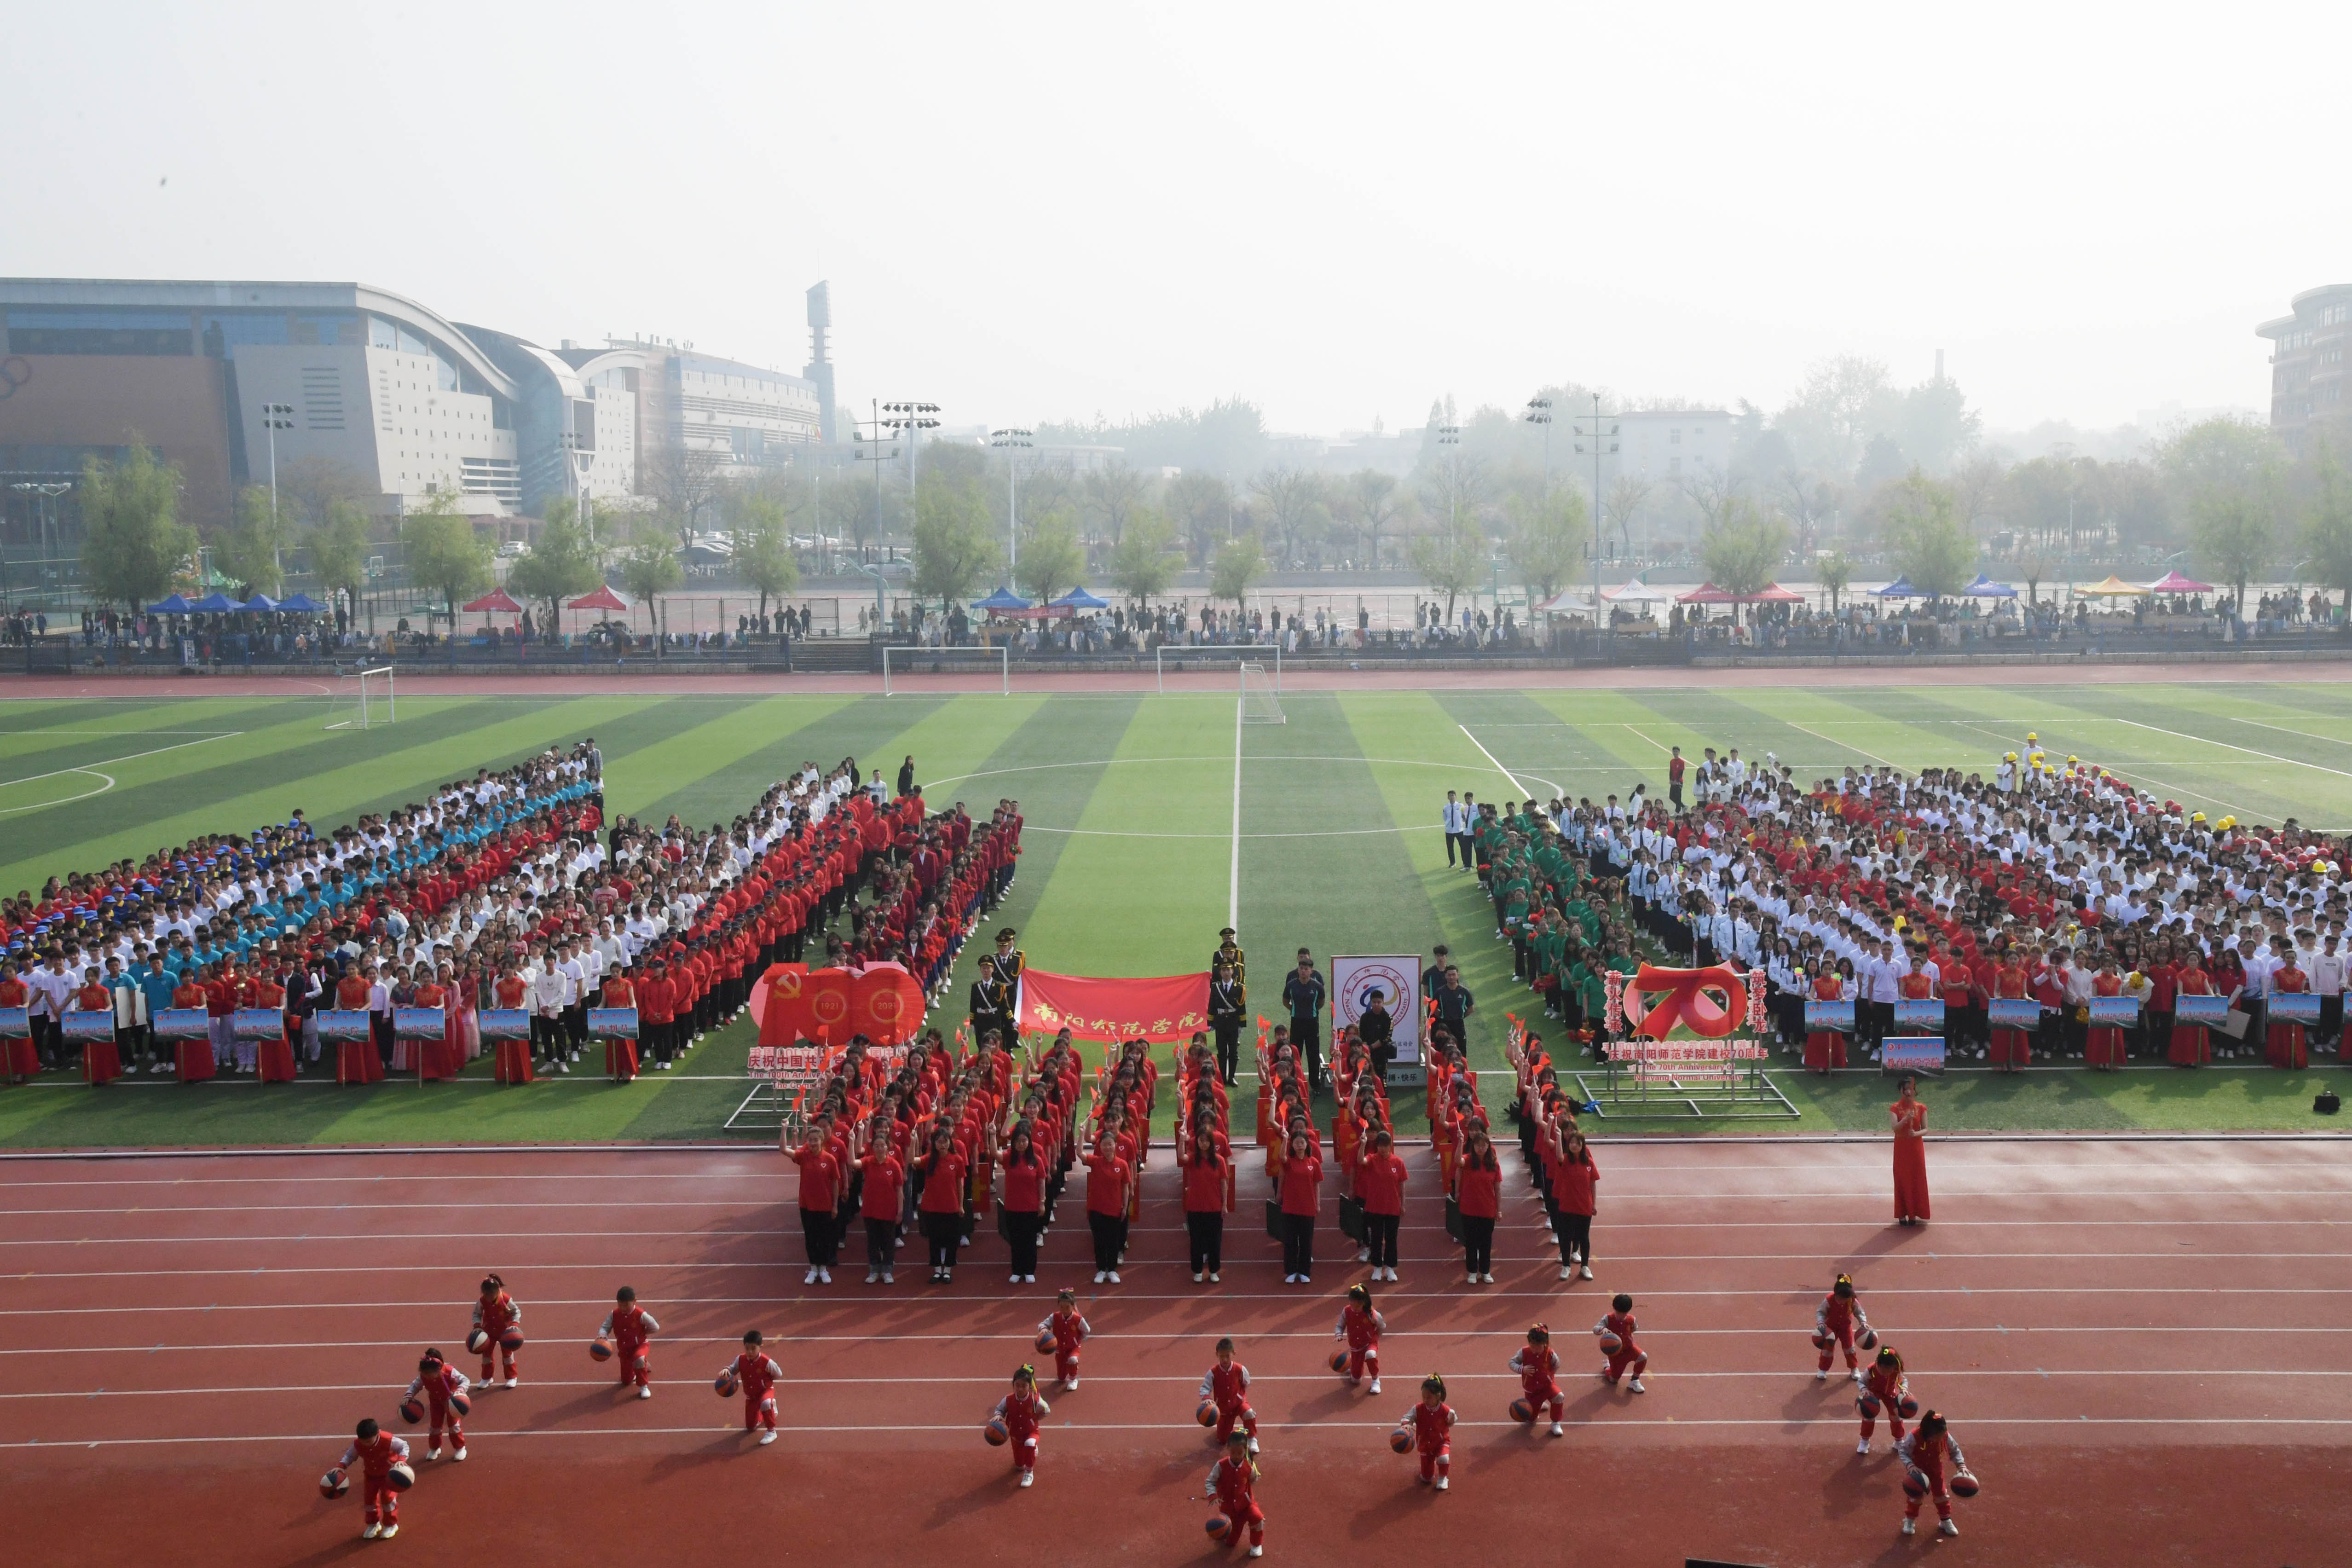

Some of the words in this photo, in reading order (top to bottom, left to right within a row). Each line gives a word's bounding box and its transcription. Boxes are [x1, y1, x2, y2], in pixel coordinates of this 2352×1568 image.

[1608, 972, 1622, 1031] 薪火传承
[1752, 971, 1767, 1032] 筑梦卧龙
[327, 1026, 359, 1036] 法学院
[1034, 1003, 1204, 1035] 南阳师范学院
[1609, 1048, 1768, 1060] 庆祝南阳师范学院建校70周年
